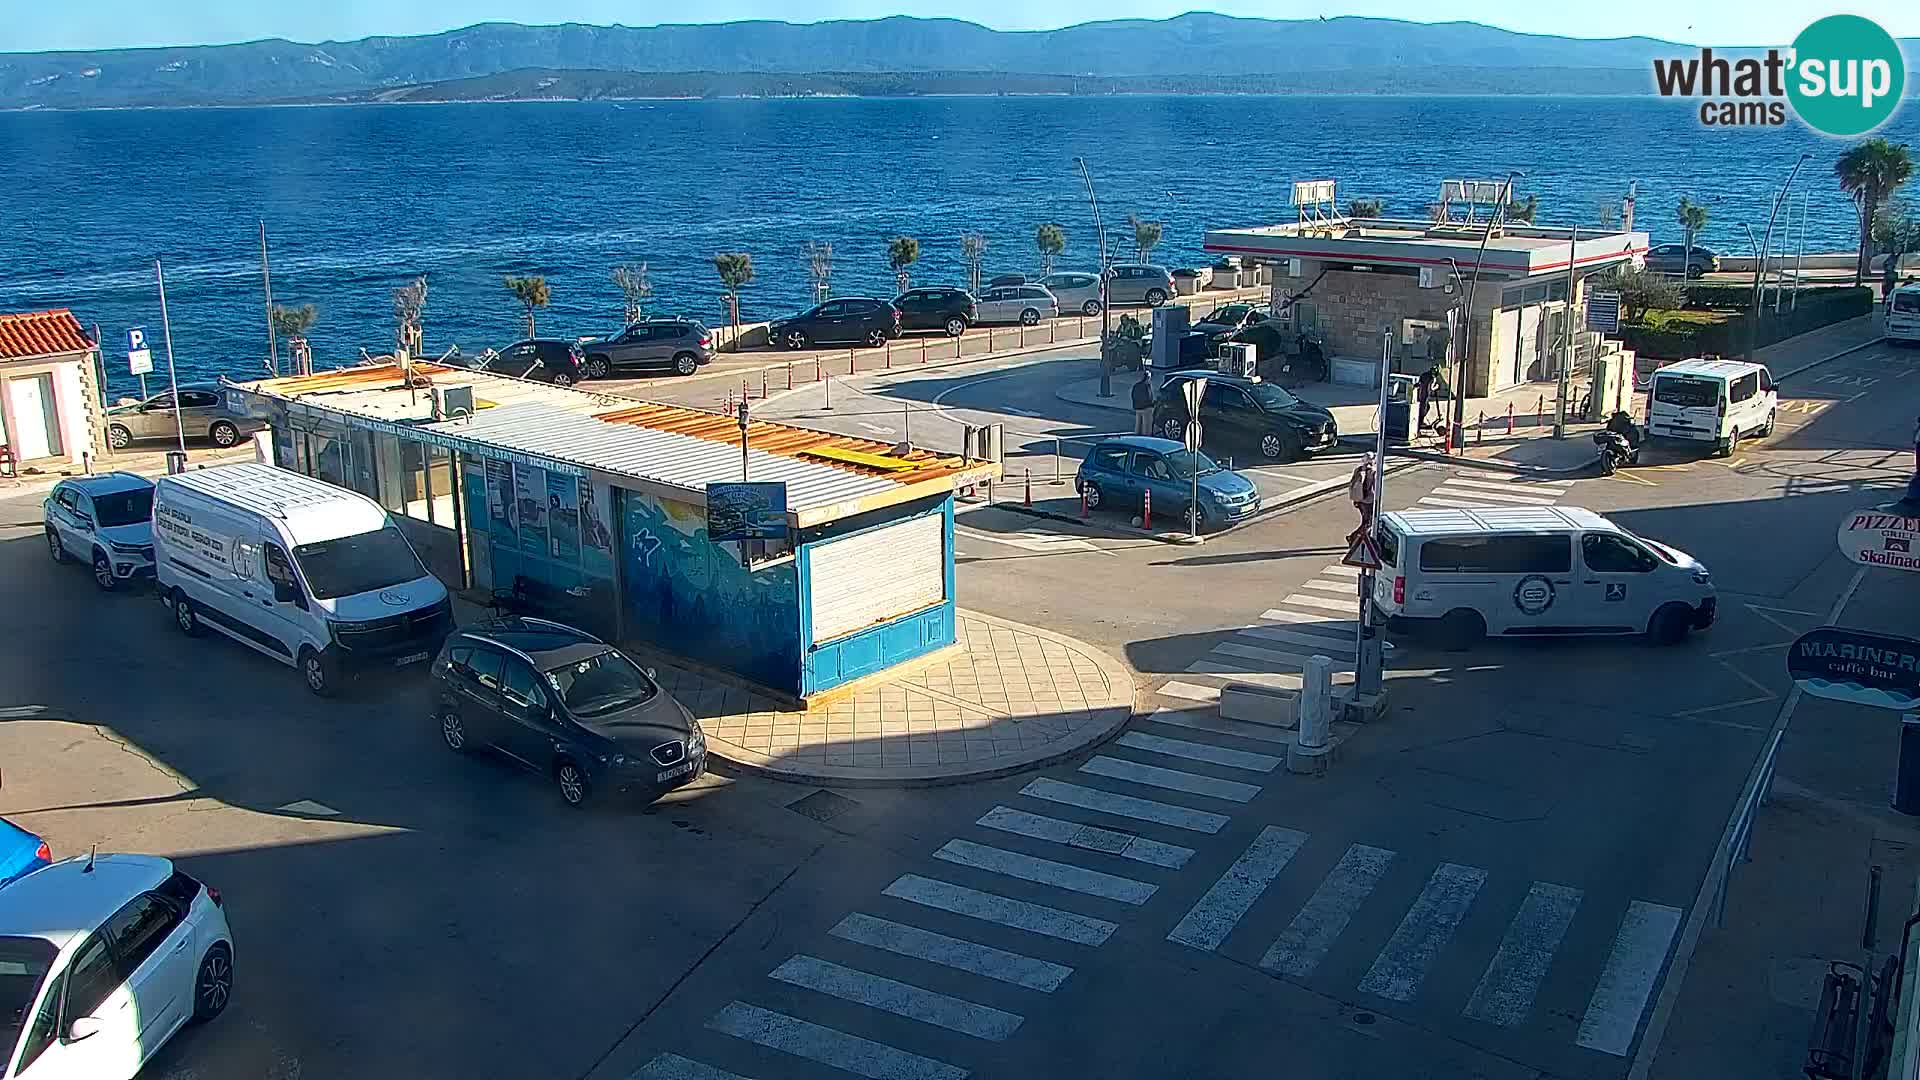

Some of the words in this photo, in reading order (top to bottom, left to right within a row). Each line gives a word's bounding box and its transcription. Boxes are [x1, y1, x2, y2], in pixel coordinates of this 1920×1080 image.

[130, 330, 144, 349] P
[437, 436, 468, 451] POSTAJA
[479, 446, 493, 457] BUS
[494, 449, 526, 464] STATION
[529, 456, 554, 471] TICKET
[556, 463, 583, 476] OFFICE
[1848, 515, 1920, 533] PIZZE
[1870, 666, 1896, 679] bar
